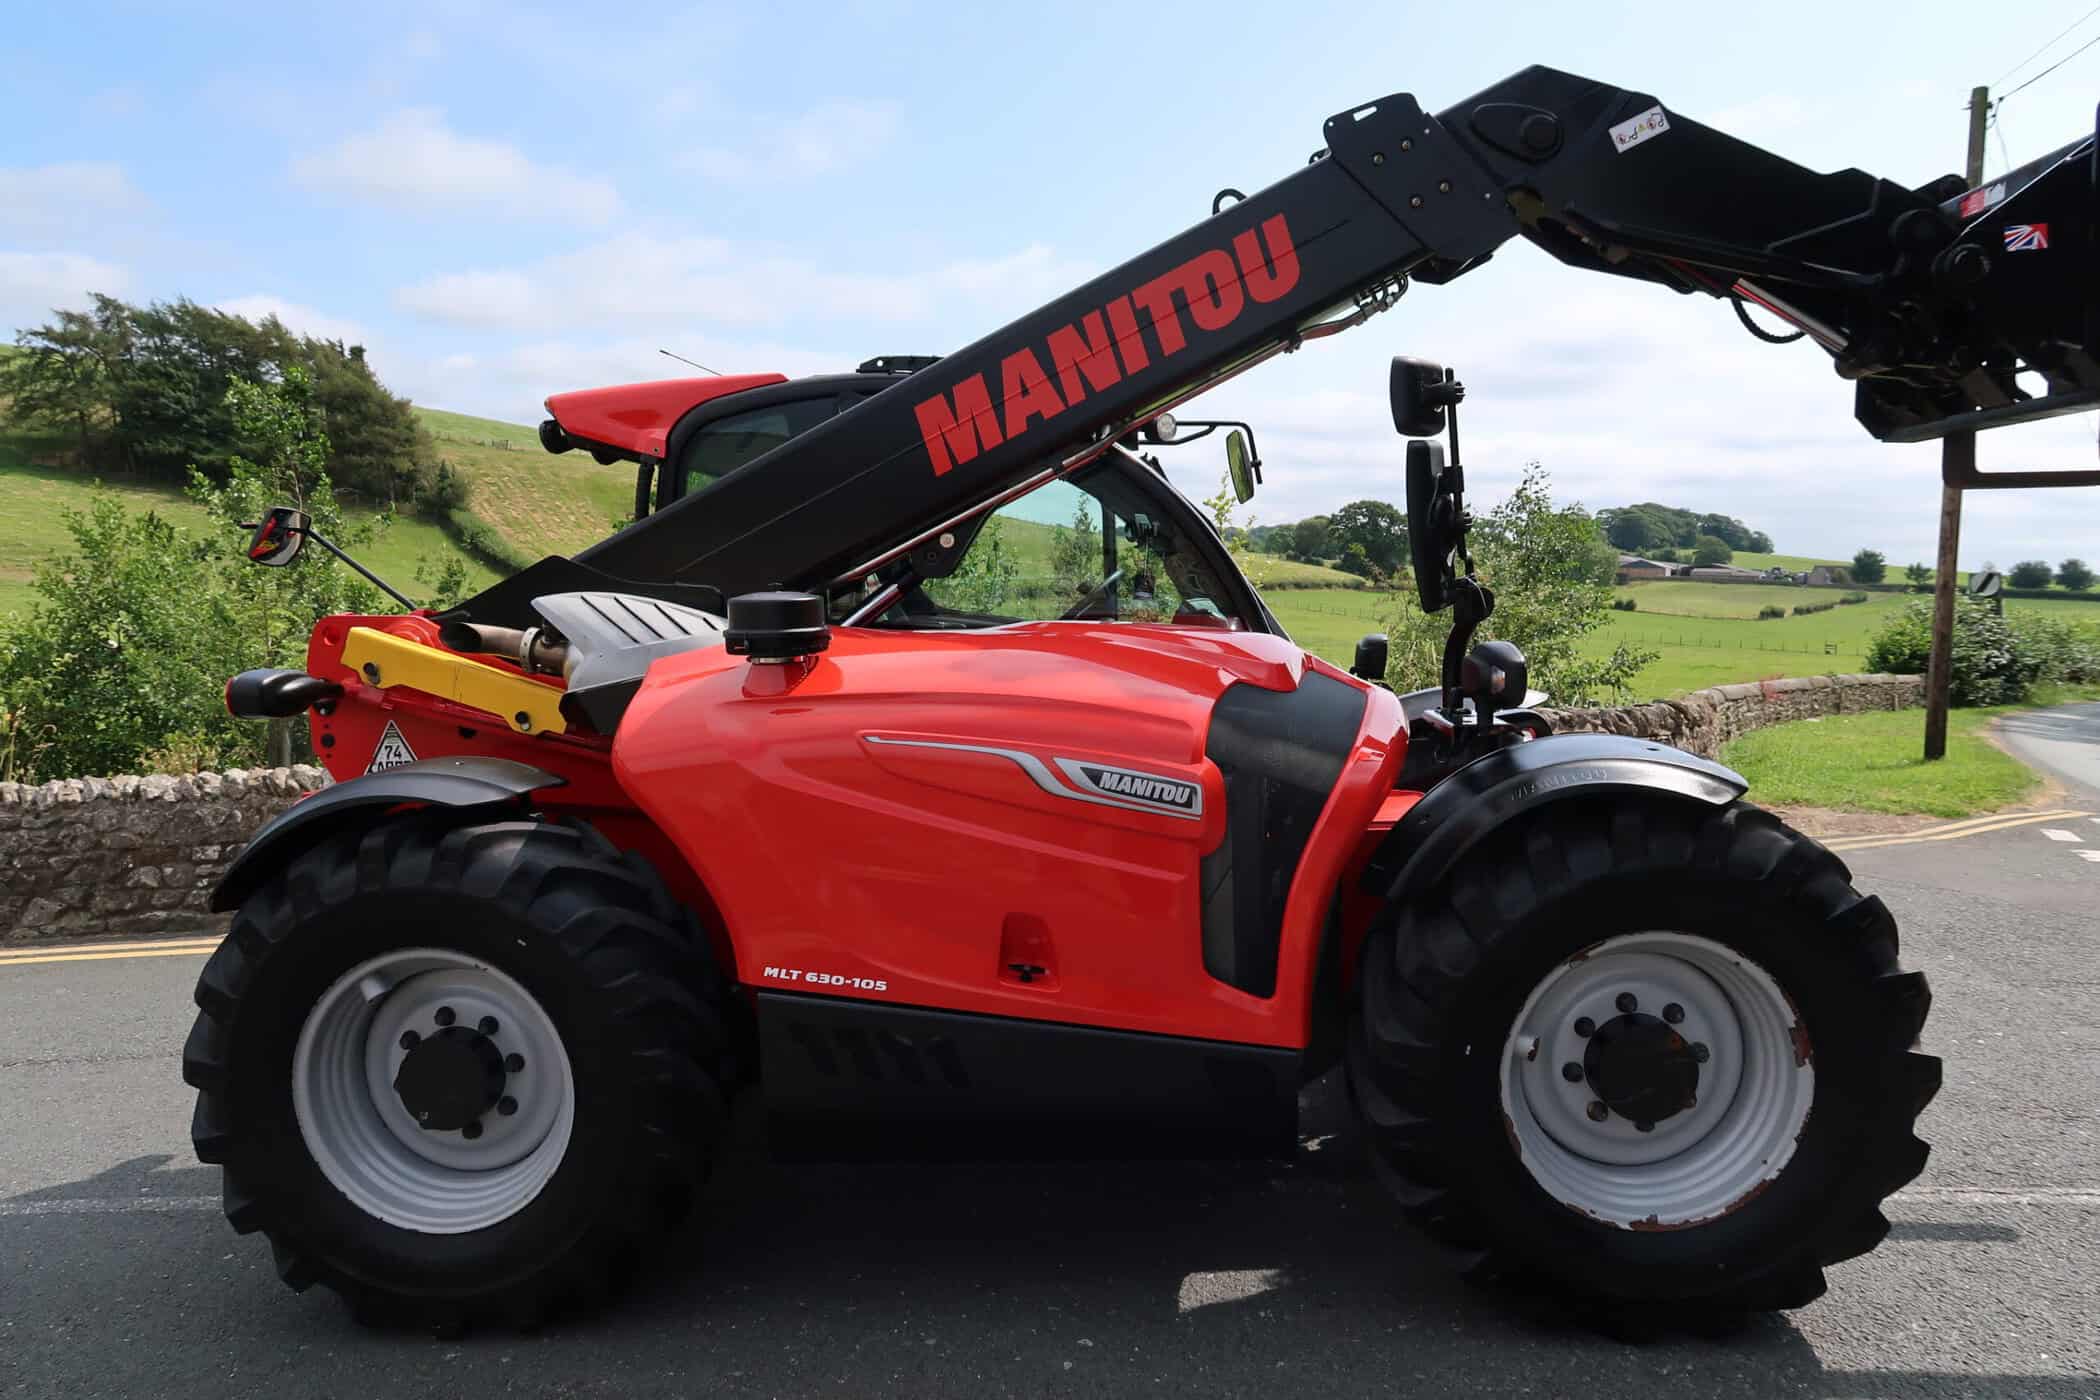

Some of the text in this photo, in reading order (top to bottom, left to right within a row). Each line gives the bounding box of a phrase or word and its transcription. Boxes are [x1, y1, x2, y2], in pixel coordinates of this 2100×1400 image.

[914, 213, 1300, 477] MANITOU
[384, 744, 402, 760] 74
[1099, 771, 1191, 804] MANITOU
[763, 966, 887, 991] MLT 630-105
